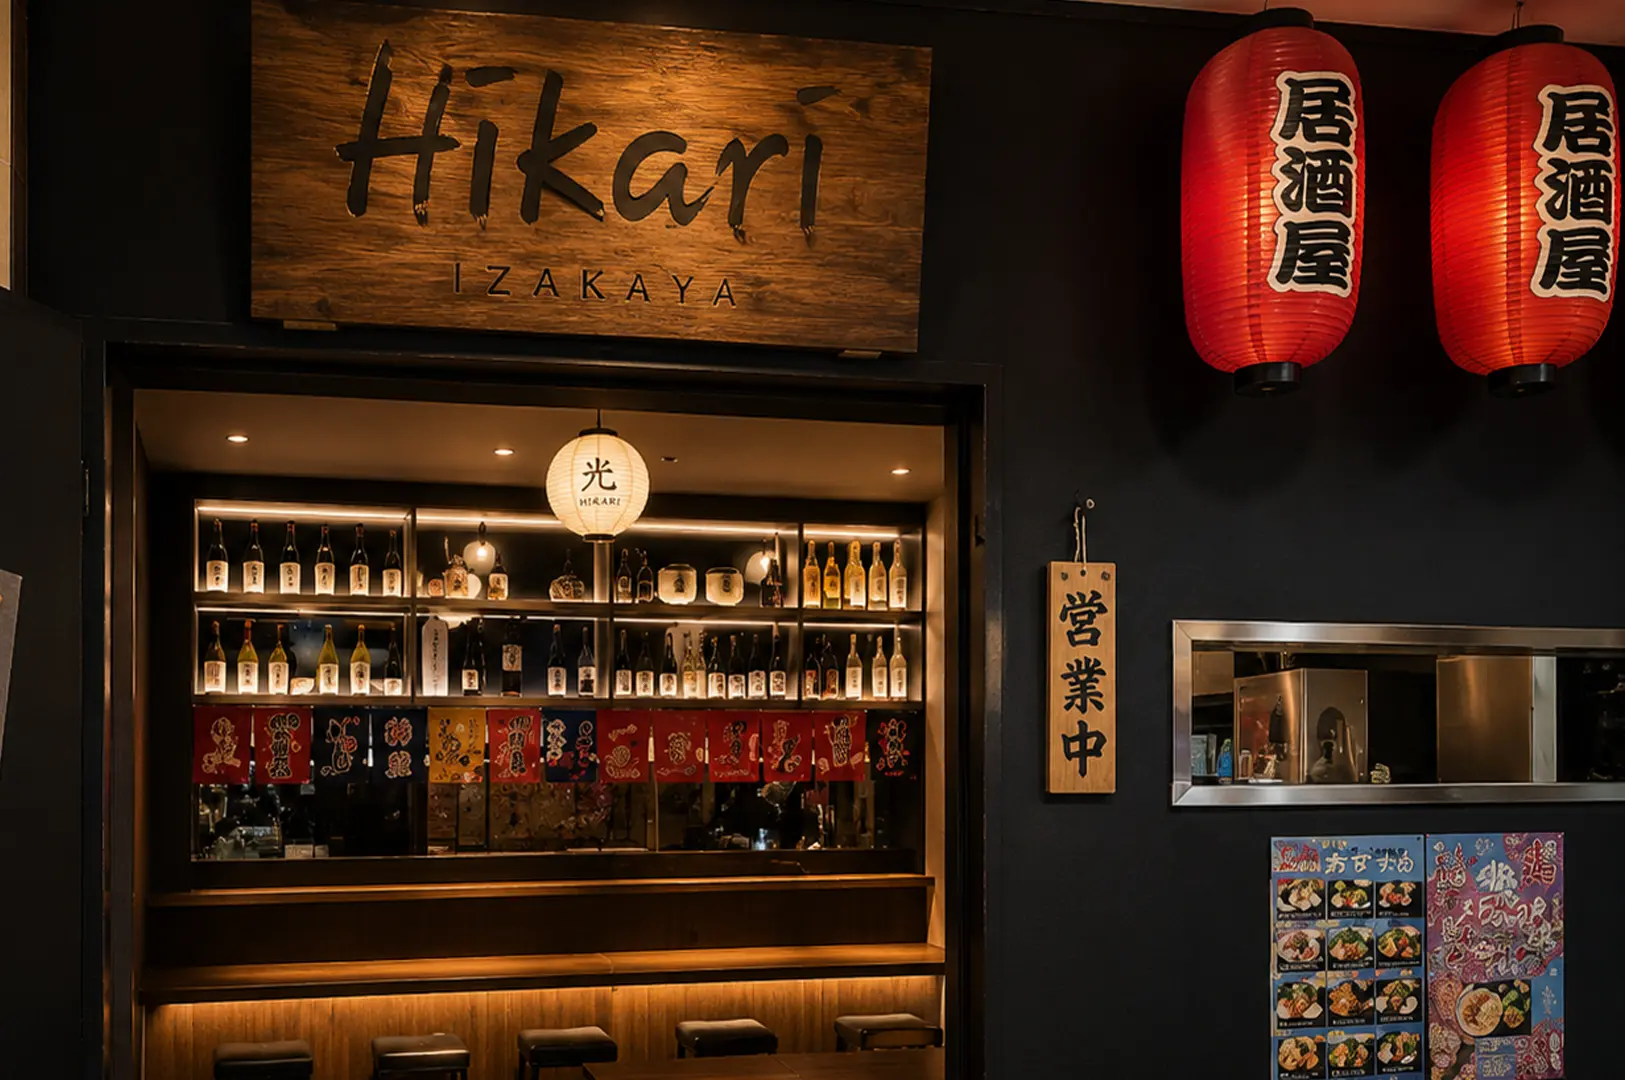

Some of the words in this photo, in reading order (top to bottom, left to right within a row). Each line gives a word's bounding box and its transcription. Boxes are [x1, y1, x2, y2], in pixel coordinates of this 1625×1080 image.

[333, 39, 842, 247] Hikari
[1276, 76, 1356, 290] 居酒屋
[1537, 90, 1614, 295] 居酒屋
[453, 261, 737, 308] IZAKAYA
[579, 497, 621, 507] HIKARI
[581, 457, 618, 492] 光
[1059, 589, 1109, 779] 営業中
